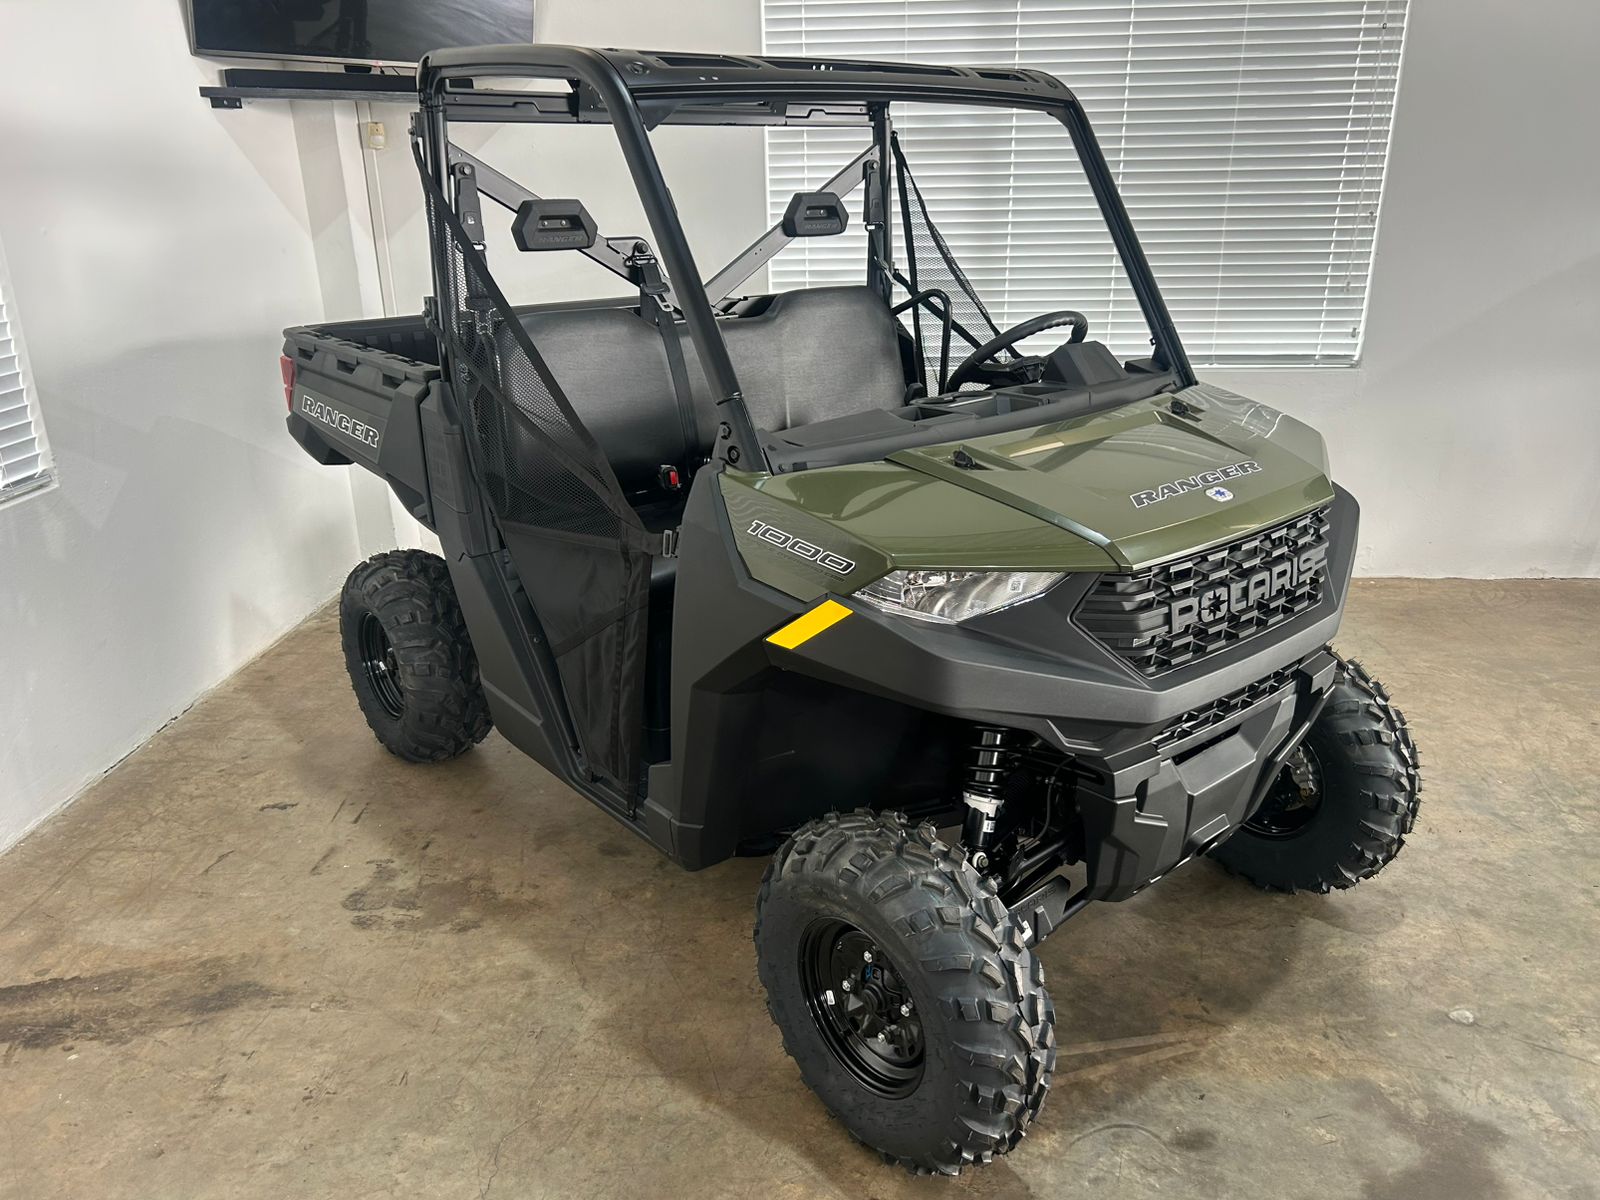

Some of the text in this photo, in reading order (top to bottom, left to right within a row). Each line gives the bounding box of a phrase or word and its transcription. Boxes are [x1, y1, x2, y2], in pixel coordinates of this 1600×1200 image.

[539, 234, 586, 243] RANGER
[301, 394, 380, 448] RANGER
[1130, 461, 1263, 508] RANGER
[746, 519, 856, 575] 1000
[1171, 550, 1317, 635] POLARIS
